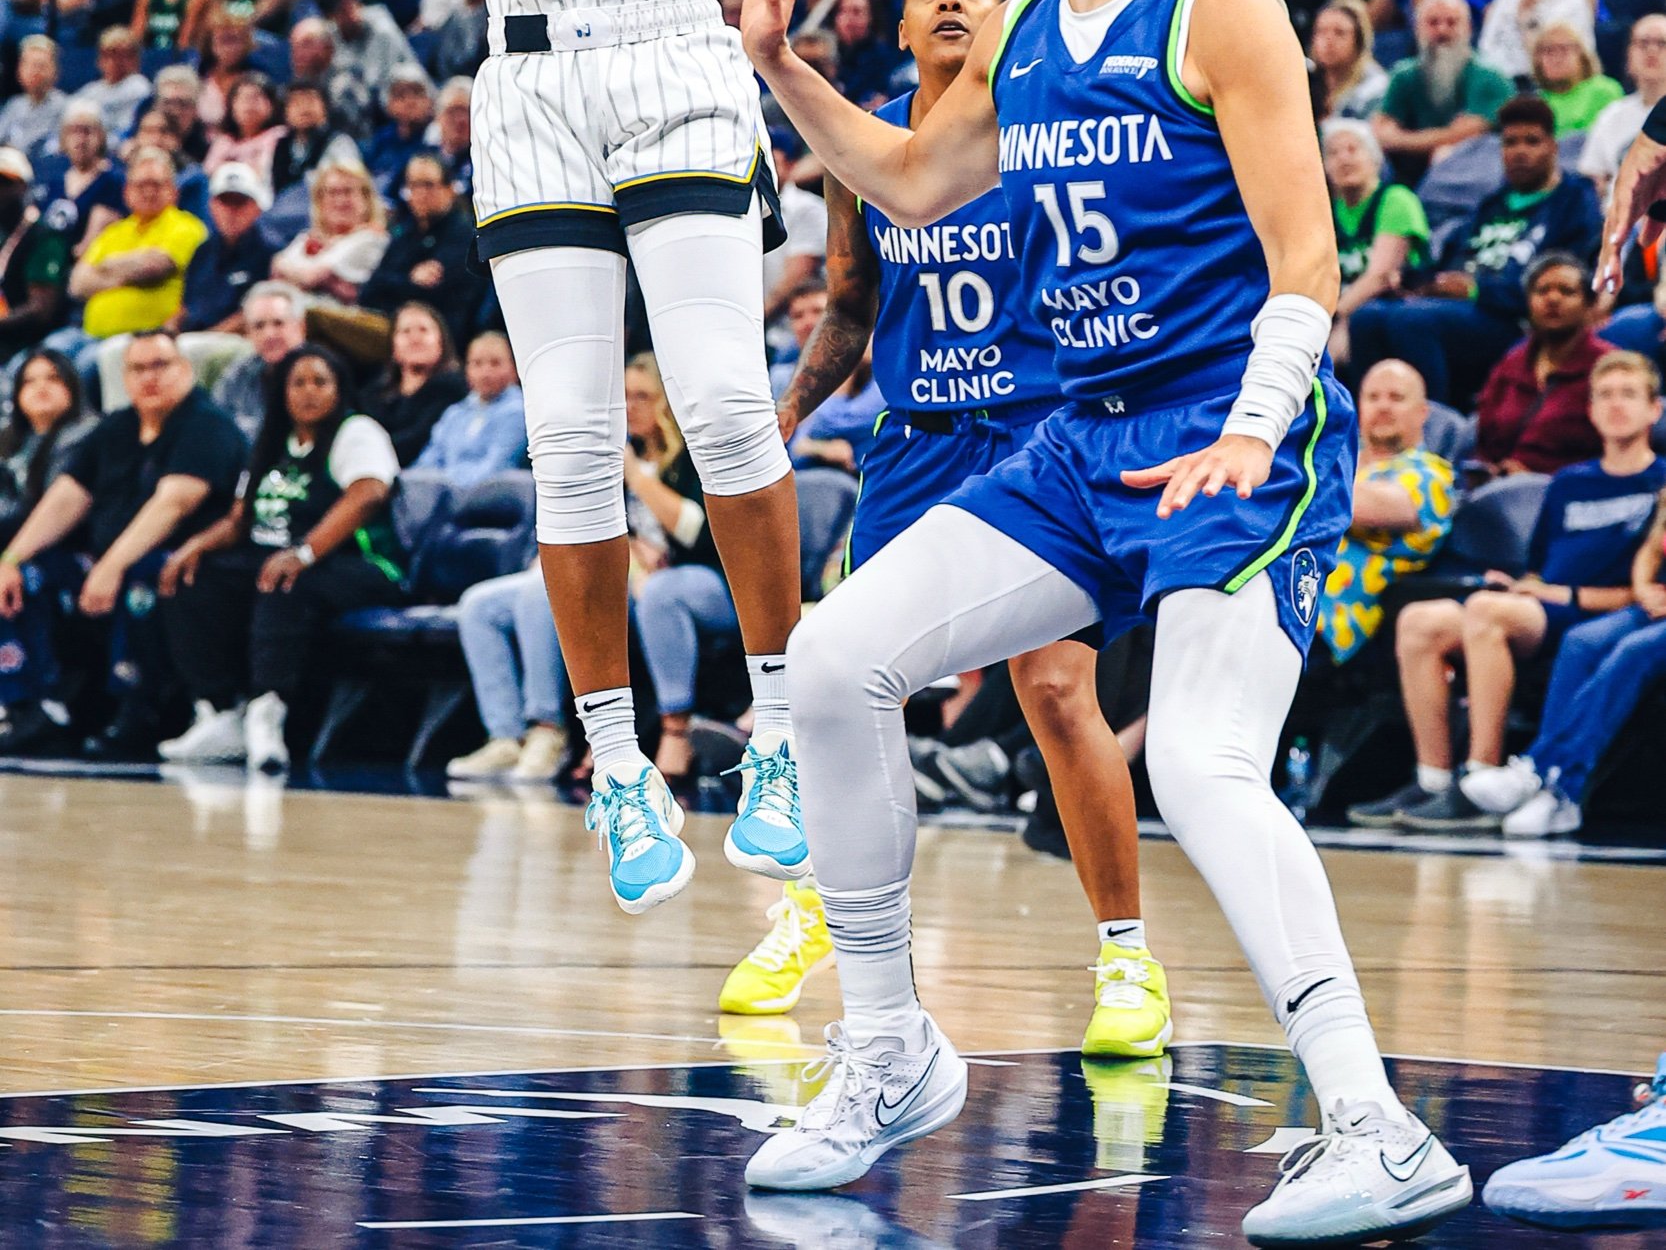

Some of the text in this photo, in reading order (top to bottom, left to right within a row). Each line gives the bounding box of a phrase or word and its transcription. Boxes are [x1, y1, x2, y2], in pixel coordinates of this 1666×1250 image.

[998, 113, 1174, 173] MINNESOTA
[874, 221, 1016, 265] MINNESOT
[1033, 180, 1120, 267] 15
[918, 270, 994, 333] 10
[1041, 275, 1141, 312] MAYO
[1051, 312, 1160, 348] CLINIC
[919, 344, 1002, 373] MAYO
[910, 370, 1016, 404] CLINIC
